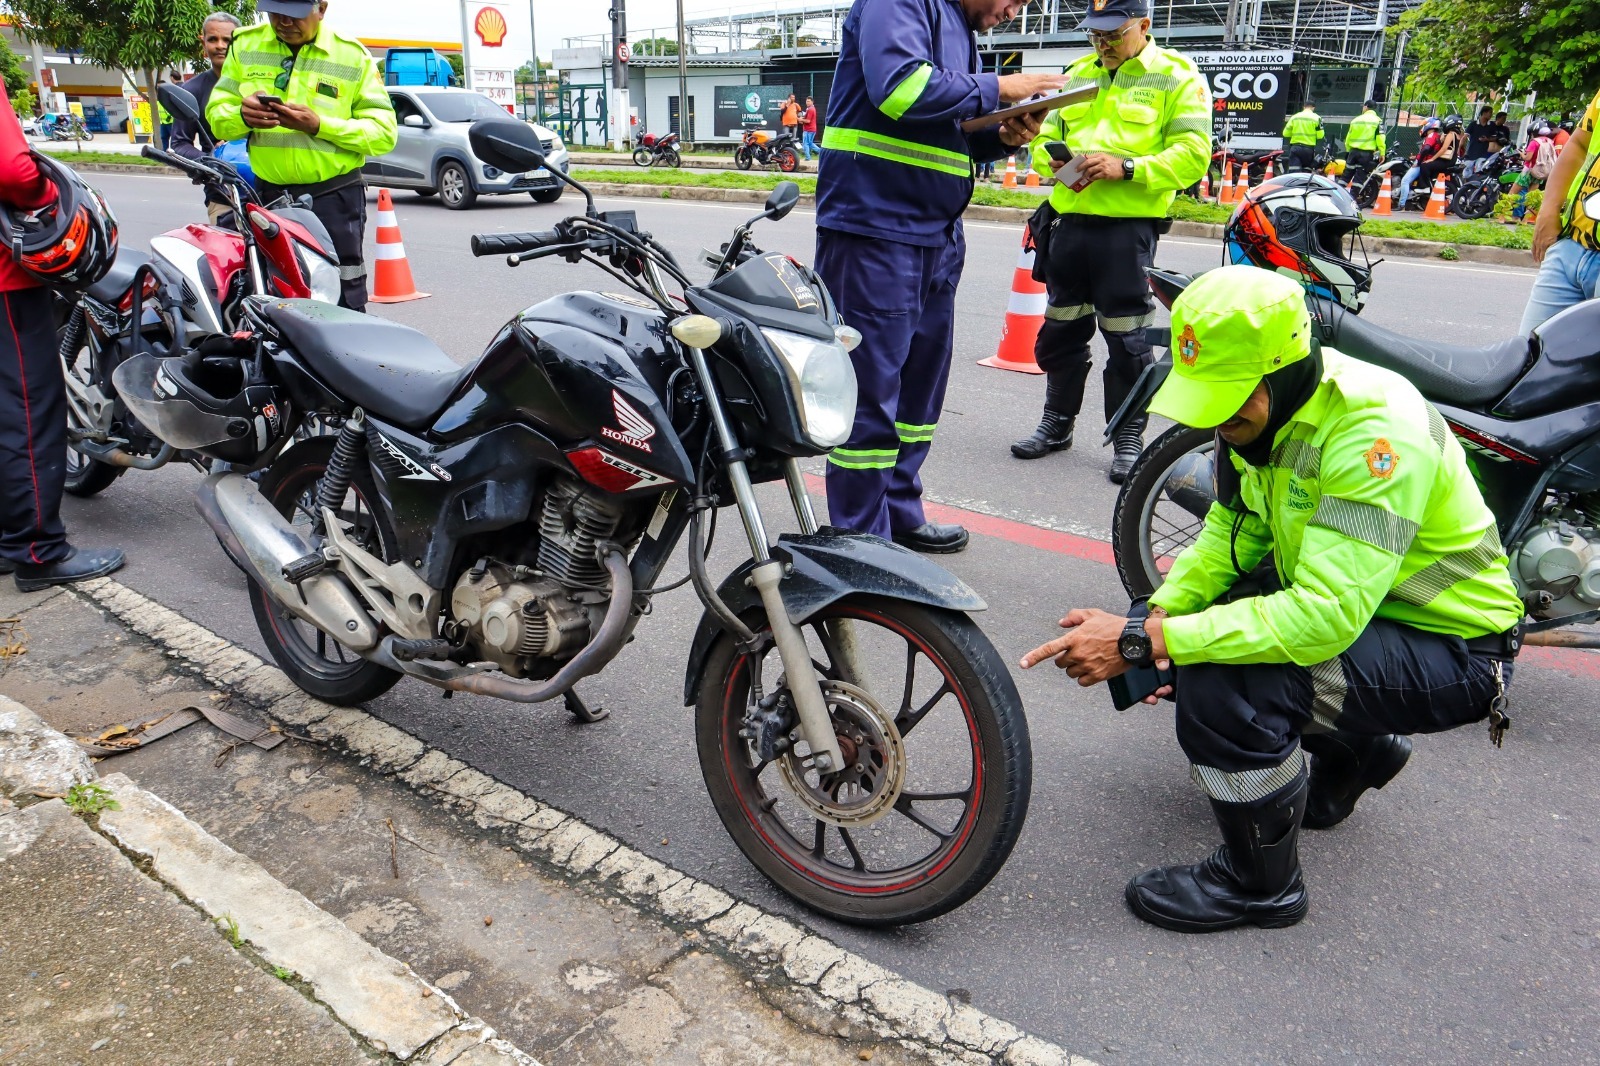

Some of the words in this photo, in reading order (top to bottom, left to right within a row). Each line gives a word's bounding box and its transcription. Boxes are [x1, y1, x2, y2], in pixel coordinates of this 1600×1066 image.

[1218, 55, 1247, 63] NOVO
[1249, 55, 1284, 63] ALEIXO
[488, 71, 505, 82] 7.29
[1200, 72, 1279, 99] SCO
[1335, 75, 1368, 83] ANUNCIE
[489, 88, 506, 99] 5.49
[1227, 102, 1264, 110] MANAUS
[601, 426, 652, 453] HONDA
[1456, 435, 1514, 463] 60
[380, 440, 424, 476] FAN
[602, 455, 659, 482] 160
